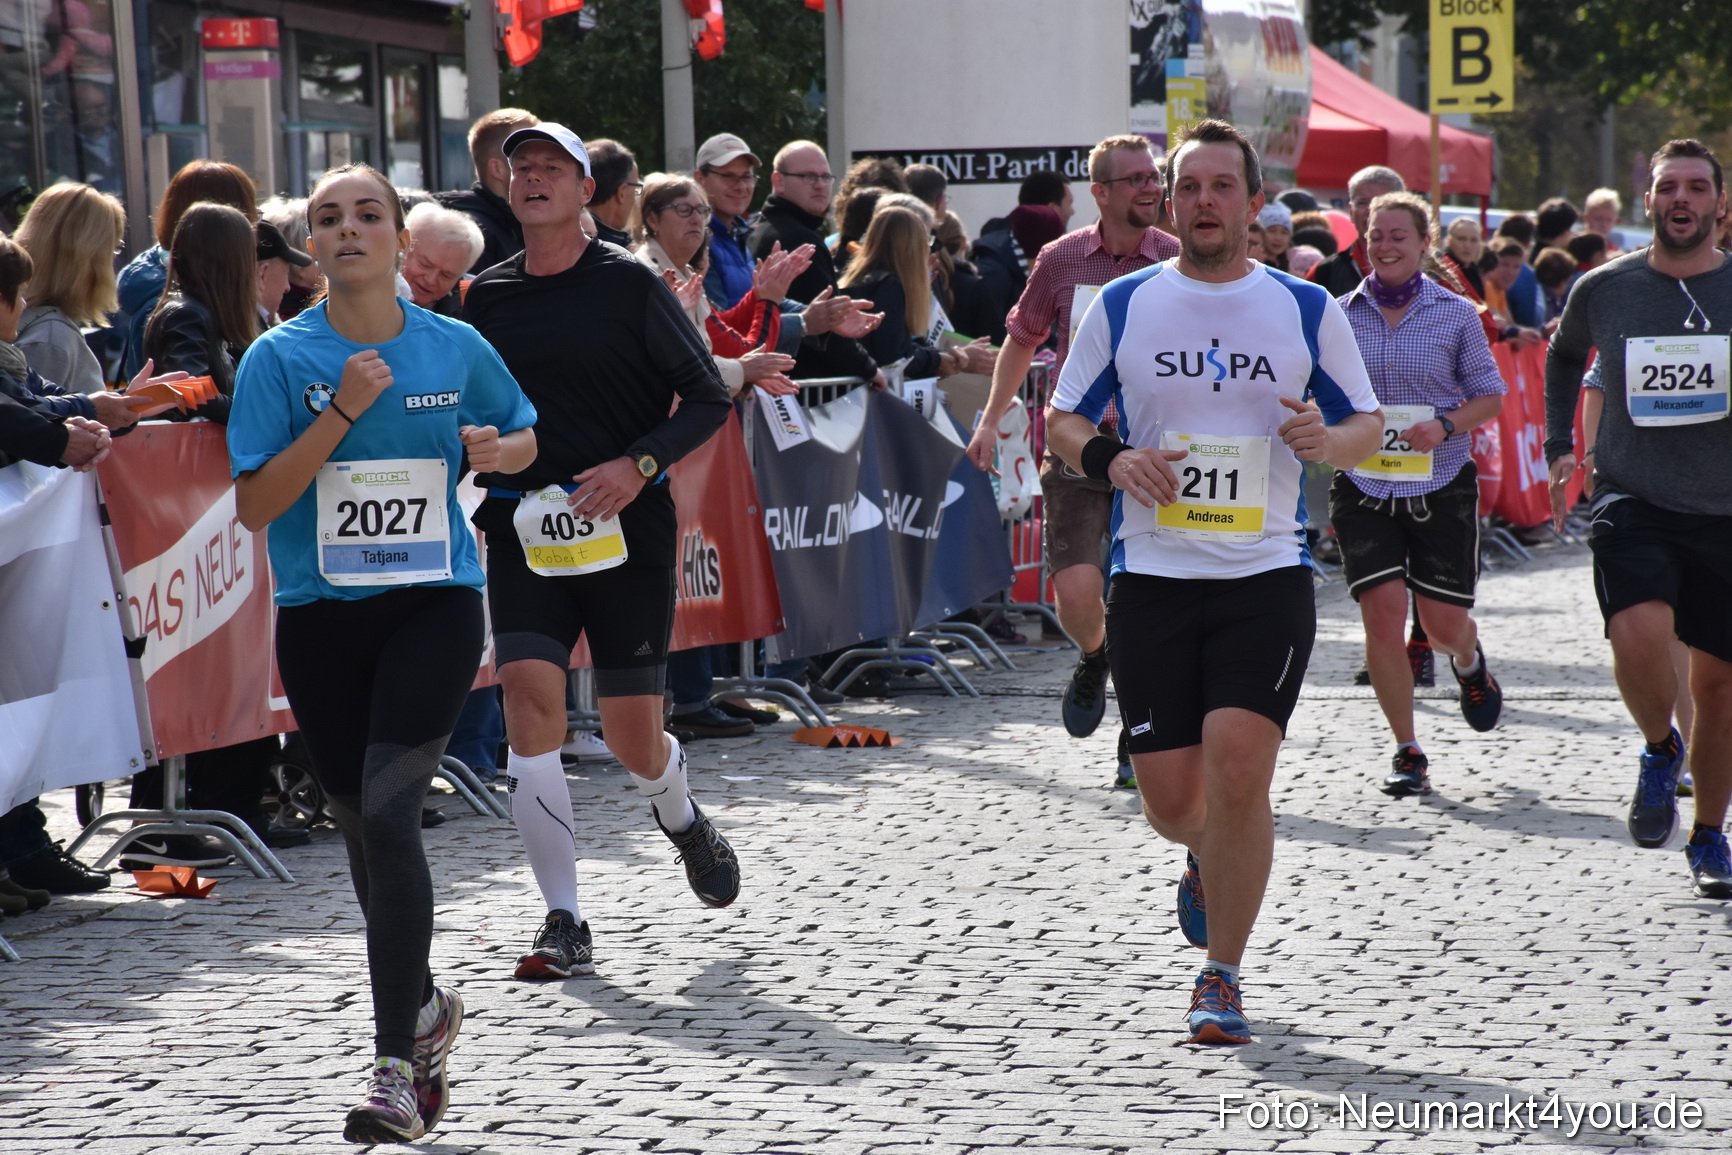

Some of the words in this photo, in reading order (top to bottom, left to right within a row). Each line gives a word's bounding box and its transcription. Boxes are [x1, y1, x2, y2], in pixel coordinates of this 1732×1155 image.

[1440, 0, 1503, 16] Block
[1452, 27, 1492, 85] B
[1664, 344, 1700, 352] BOCK
[1154, 340, 1277, 389] SUSPA
[1641, 363, 1715, 391] 2524
[405, 391, 459, 409] BOCK
[772, 394, 792, 422] wn
[1653, 400, 1705, 410] Alexander
[1201, 445, 1239, 455] BOCK
[1381, 459, 1402, 468] Karin
[365, 471, 410, 483] BOCK
[1181, 466, 1239, 500] 211
[337, 498, 427, 537] 2027
[1187, 510, 1234, 523] Andreas
[541, 511, 594, 541] 403
[362, 551, 408, 566] Tatjana
[533, 547, 588, 564] Robert
[682, 529, 721, 598] Hits
[196, 515, 245, 618] NEUE
